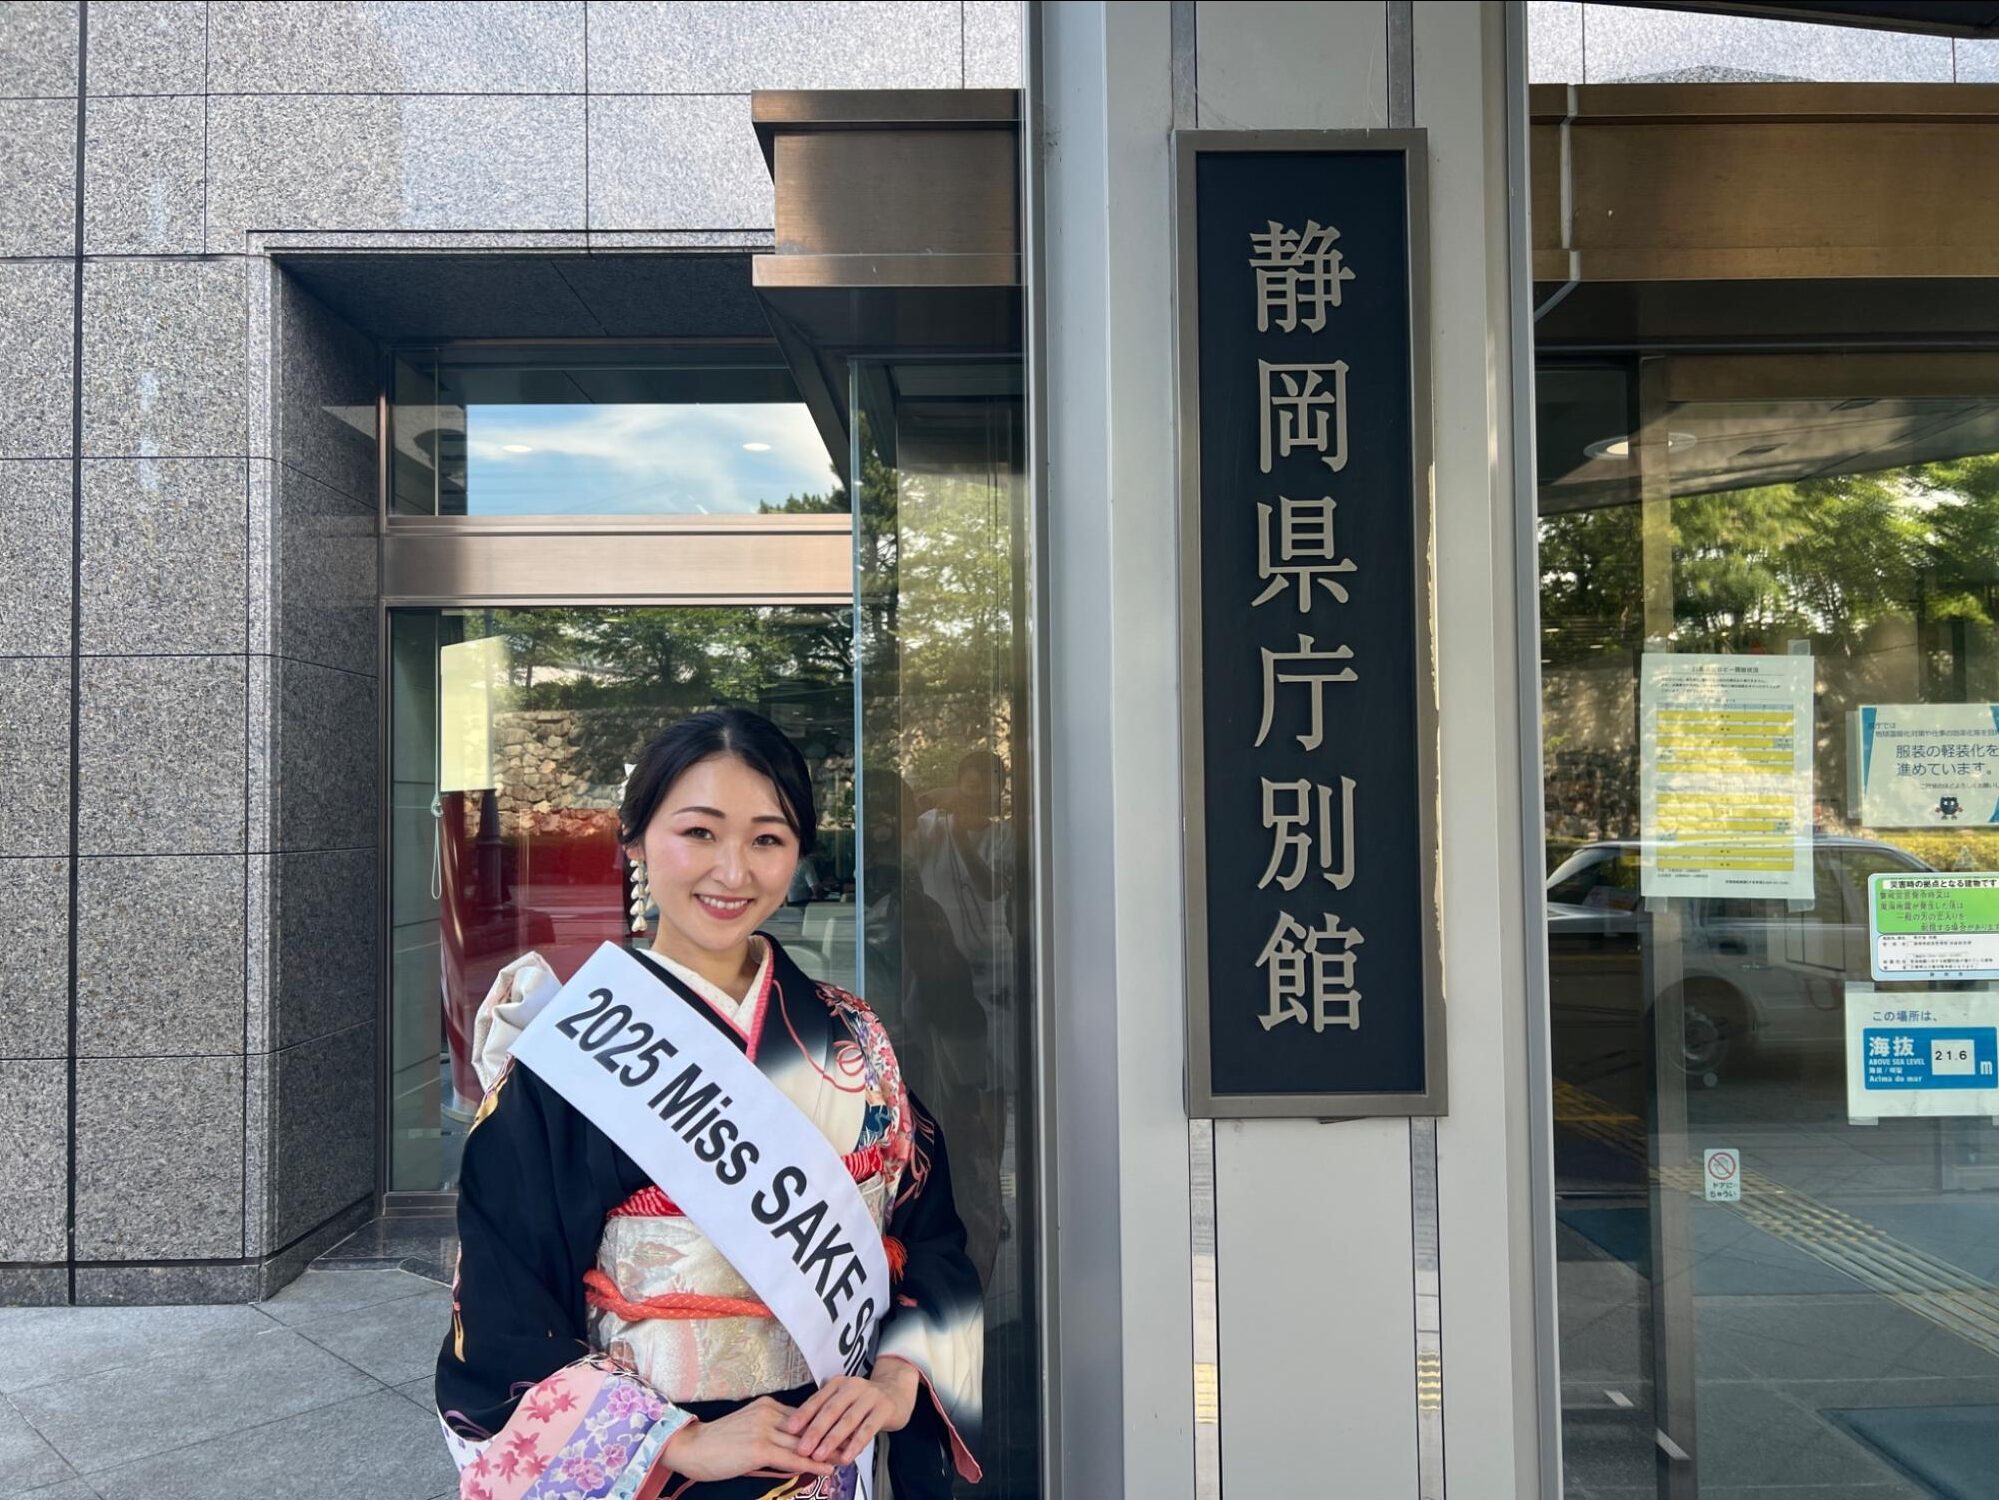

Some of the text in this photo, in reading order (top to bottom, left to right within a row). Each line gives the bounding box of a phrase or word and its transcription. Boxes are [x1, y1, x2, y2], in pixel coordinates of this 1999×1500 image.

[1249, 219, 1364, 1033] 静岡県庁別館
[1896, 743, 1999, 758] 服装の軽装化を
[1897, 762, 1991, 776] 進めています。
[1890, 879, 1997, 889] 災害時の拠点となる建物です
[1872, 1010, 1938, 1022] この場所は、
[1869, 1036, 1914, 1057] 海抜
[1868, 1058, 1926, 1066] ABOVE SEA LEVEL
[1980, 1061, 1993, 1075] m
[555, 987, 677, 1088] 2025
[648, 1062, 760, 1186] Miss
[751, 1165, 868, 1323] SAKE
